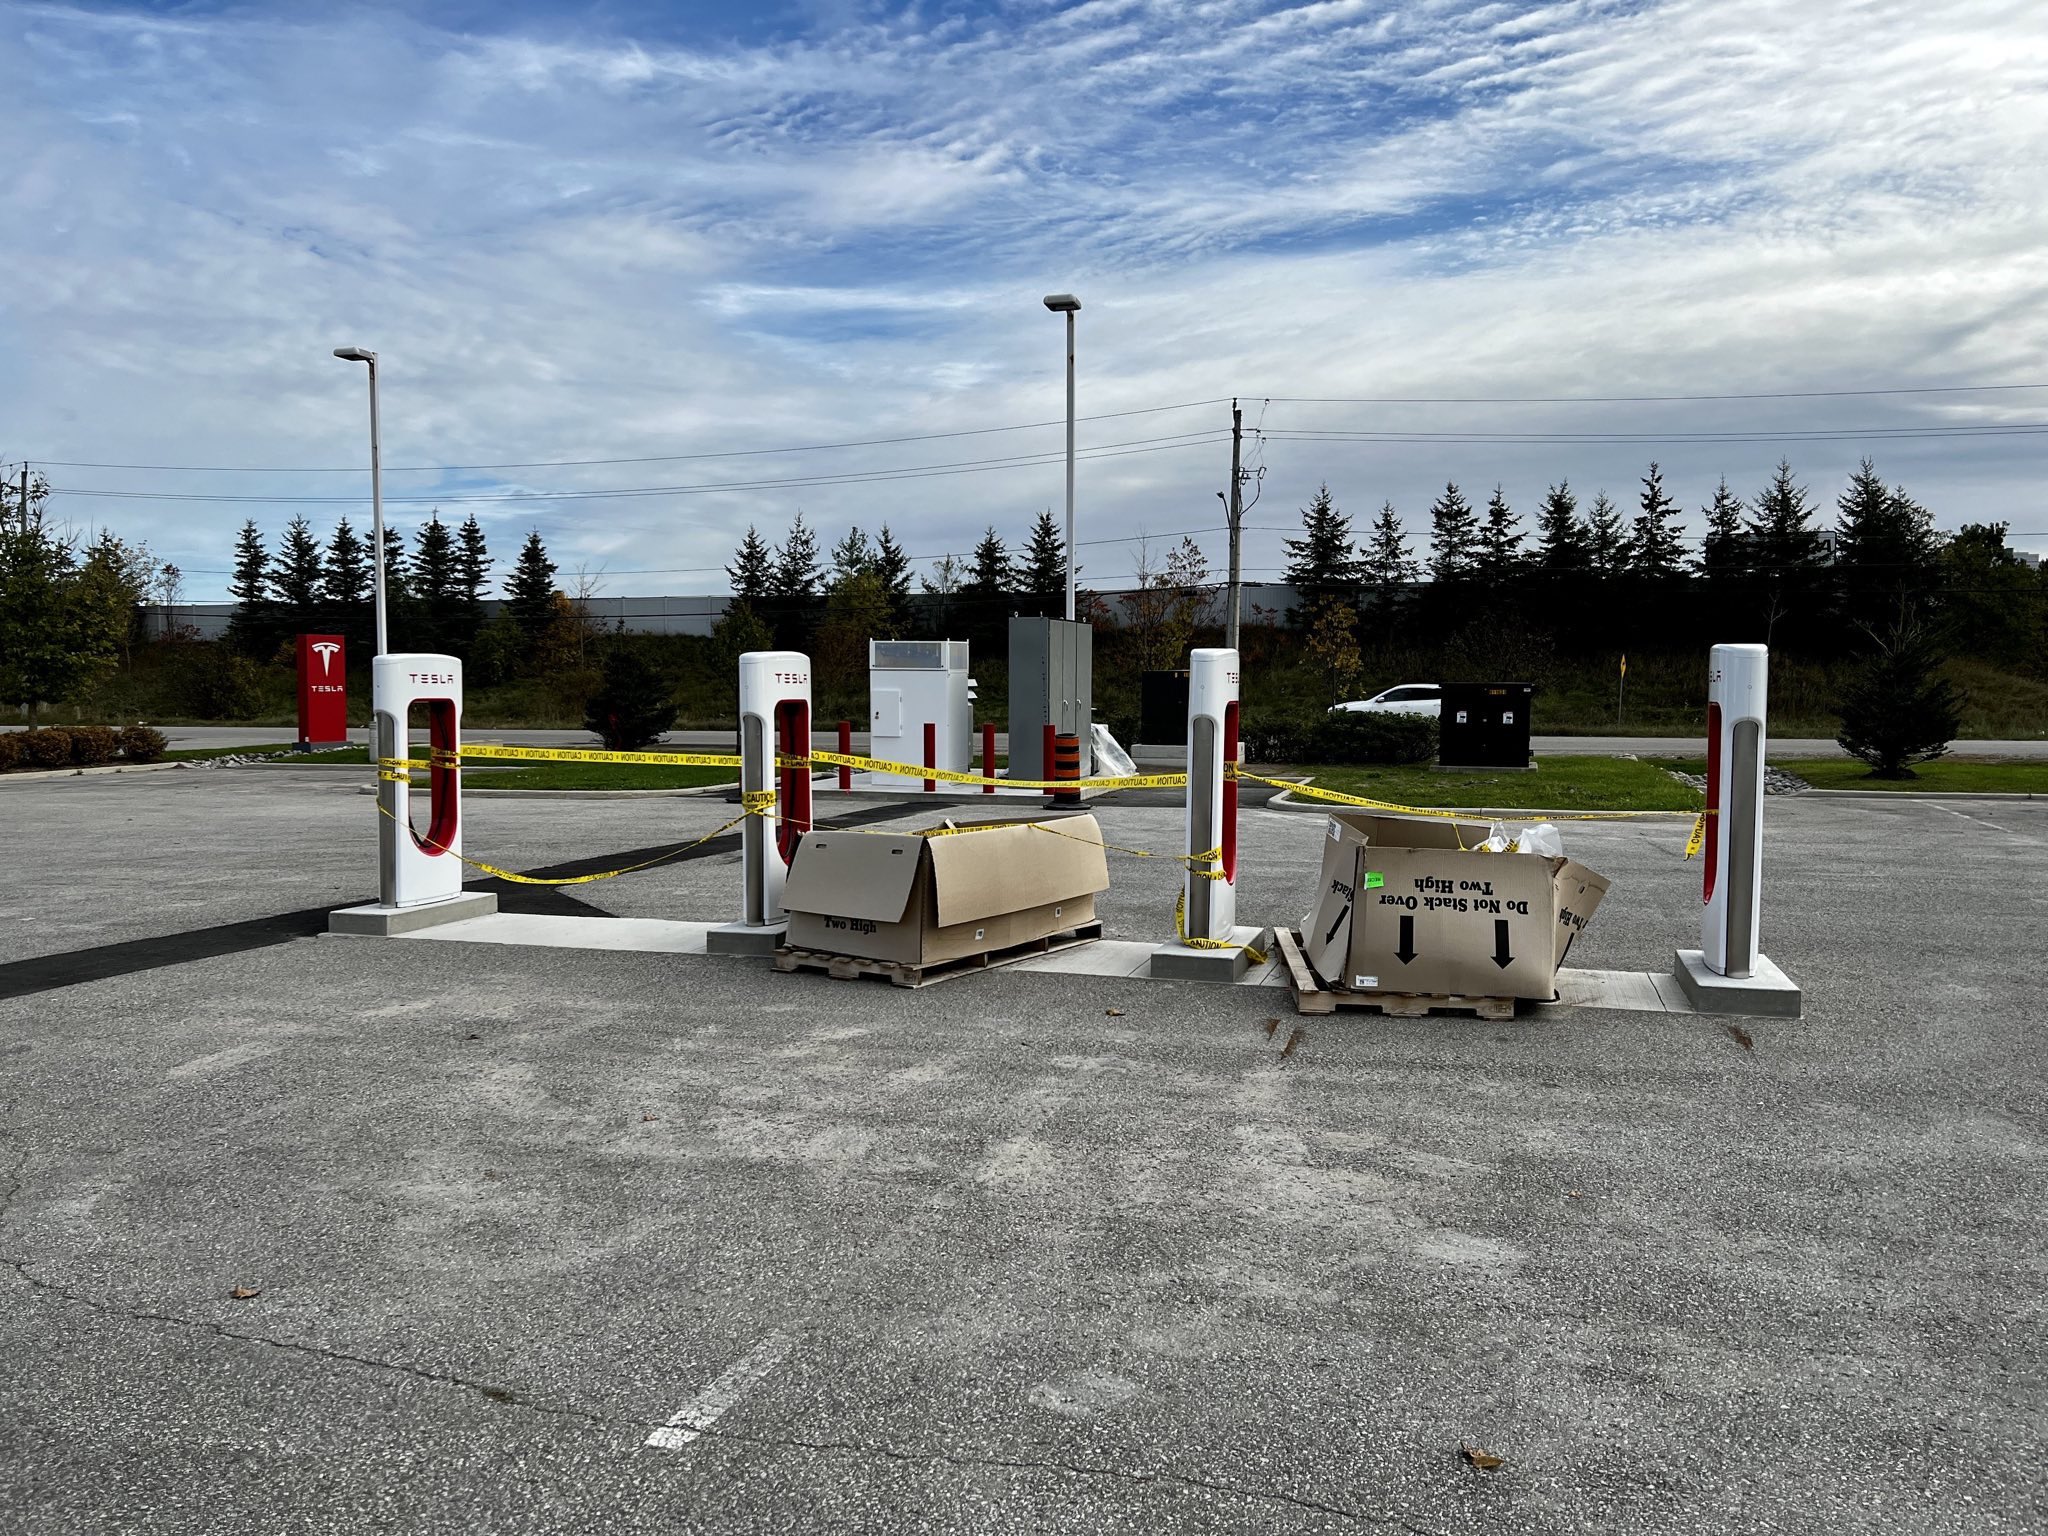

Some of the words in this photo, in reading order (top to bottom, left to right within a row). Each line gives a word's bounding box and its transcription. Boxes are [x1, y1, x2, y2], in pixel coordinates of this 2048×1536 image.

[409, 673, 453, 684] TESLA
[775, 673, 808, 684] TESLA
[1710, 670, 1721, 683] SLA
[1414, 876, 1454, 893] High
[1460, 881, 1493, 896] Two
[1379, 894, 1418, 910] Over
[1424, 896, 1468, 912] Stack
[1474, 899, 1501, 913] Not
[1506, 900, 1529, 914] Do
[1559, 907, 1573, 926] High
[1572, 915, 1584, 931] Two
[824, 915, 846, 929] Two
[850, 919, 876, 935] High
